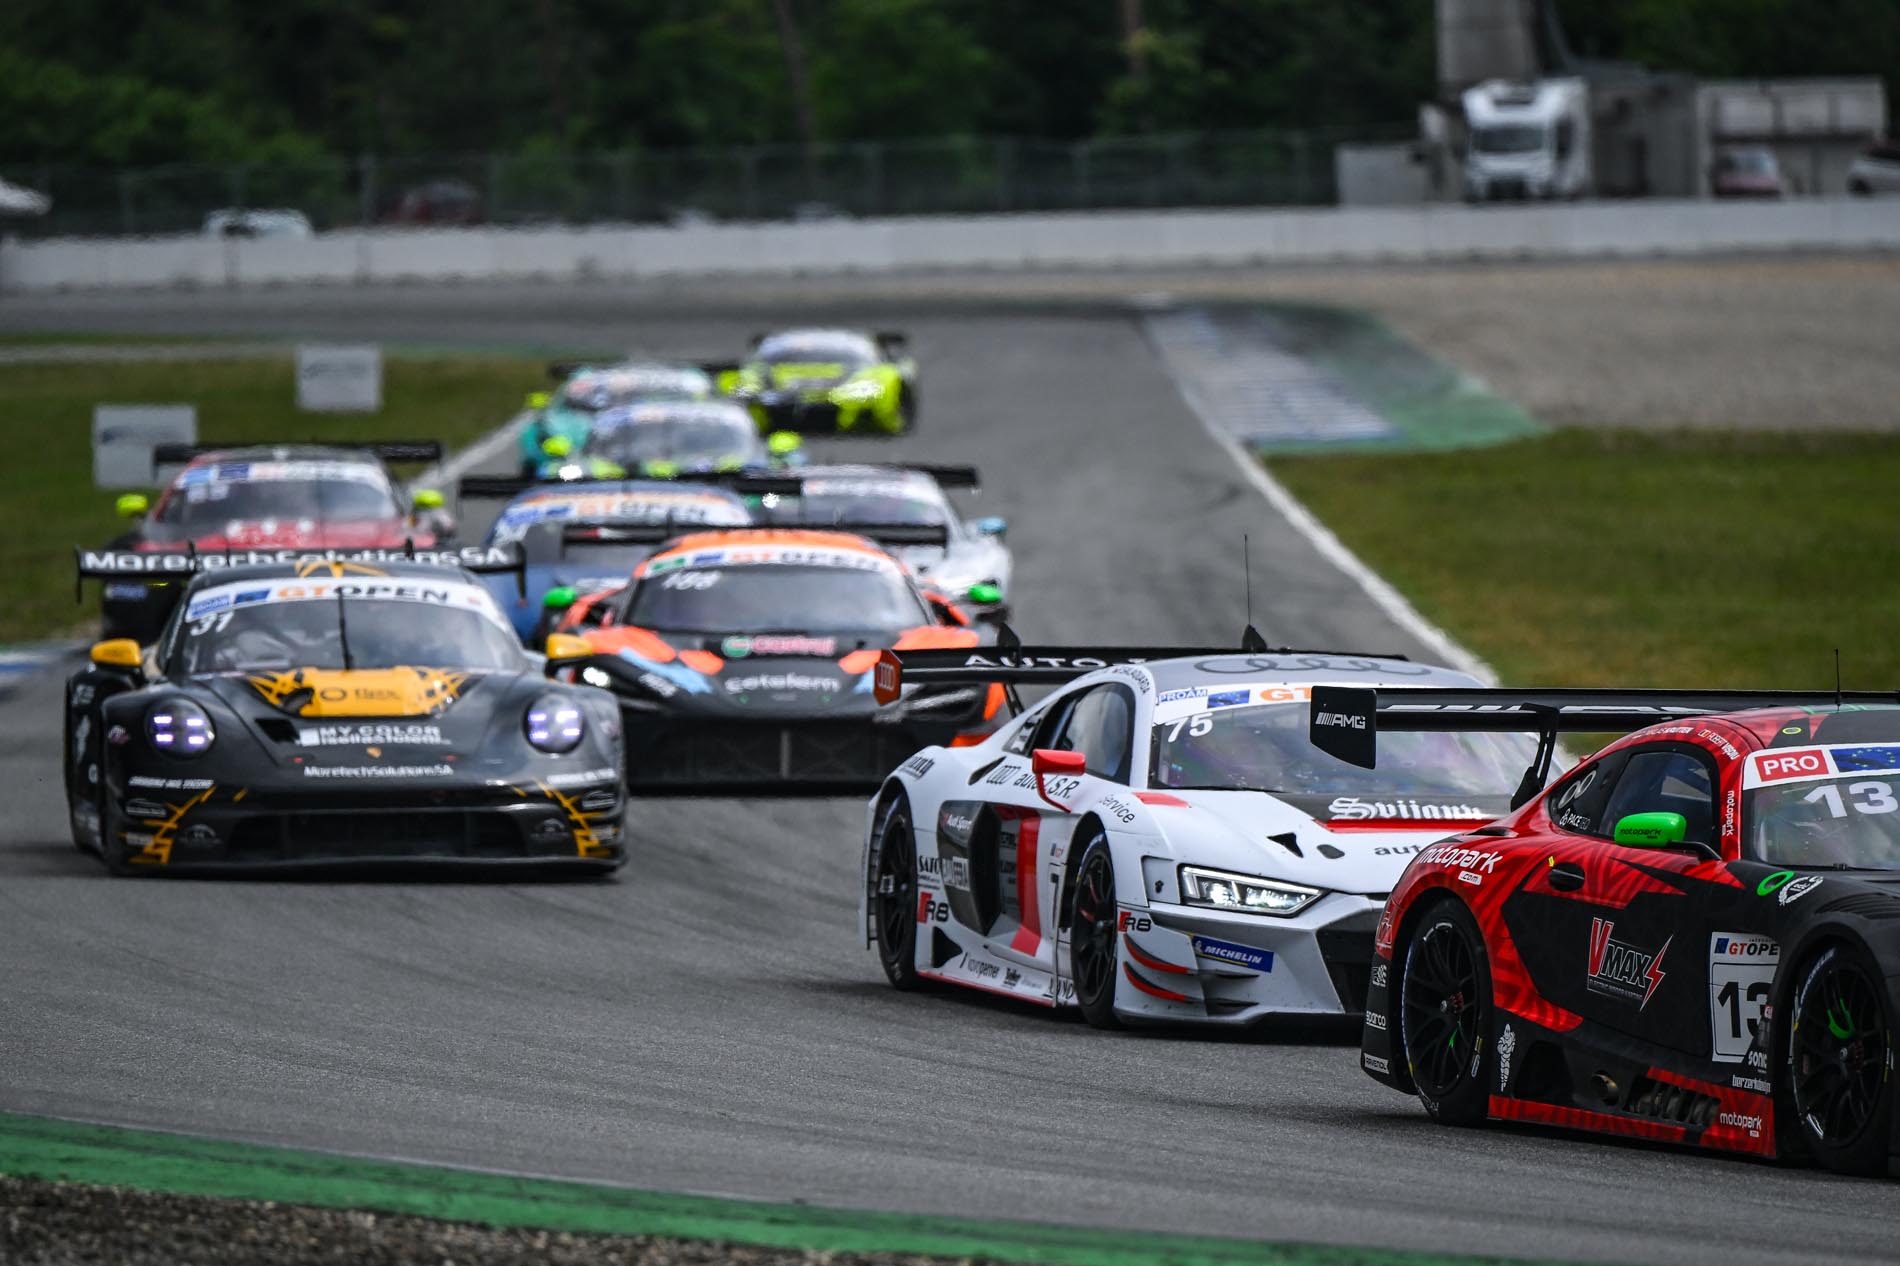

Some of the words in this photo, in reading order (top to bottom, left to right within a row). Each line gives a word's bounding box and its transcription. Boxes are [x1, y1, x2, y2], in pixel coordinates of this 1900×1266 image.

[1164, 712, 1213, 743] 75
[1763, 755, 1819, 776] PRO
[1803, 781, 1899, 818] 13
[1417, 845, 1503, 874] motopark
[1123, 917, 1152, 932] R8
[1204, 945, 1263, 964] MICHELIN
[1720, 1111, 1762, 1131] motopark
